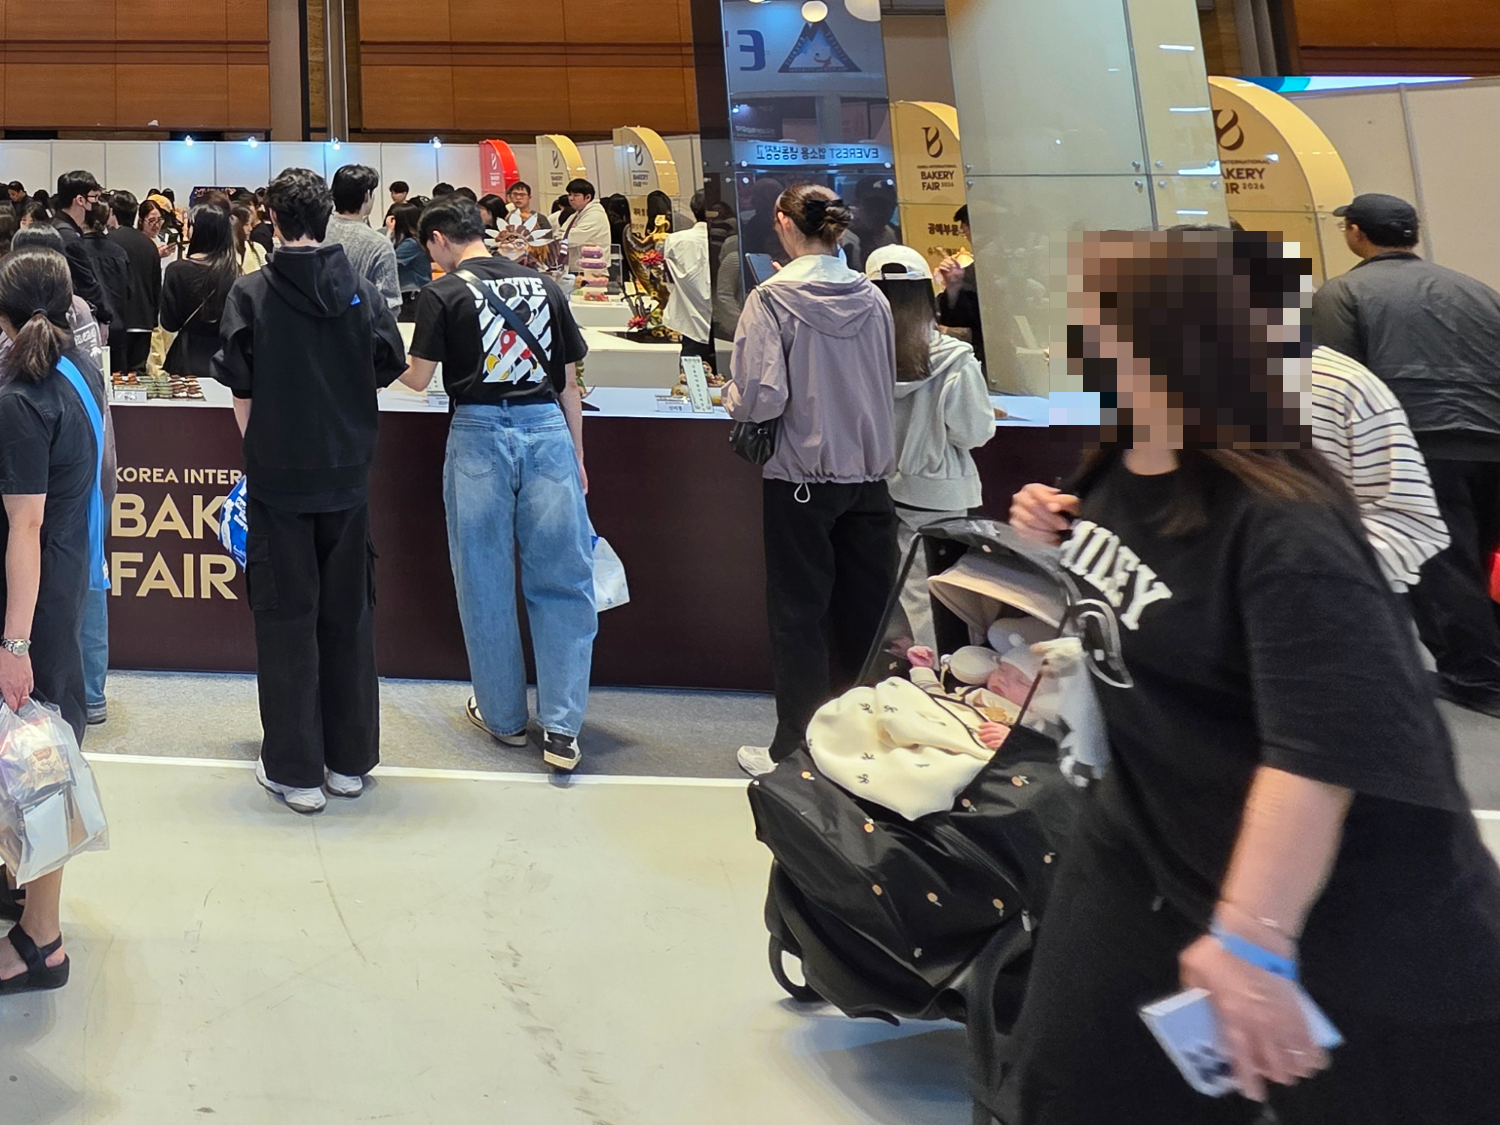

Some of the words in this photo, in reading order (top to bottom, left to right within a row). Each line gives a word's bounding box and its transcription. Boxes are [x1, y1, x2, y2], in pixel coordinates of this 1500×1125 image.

[920, 170, 955, 180] BAKERY
[921, 181, 941, 191] FAIR
[114, 466, 179, 484] KOREA
[110, 550, 239, 601] FAIR
